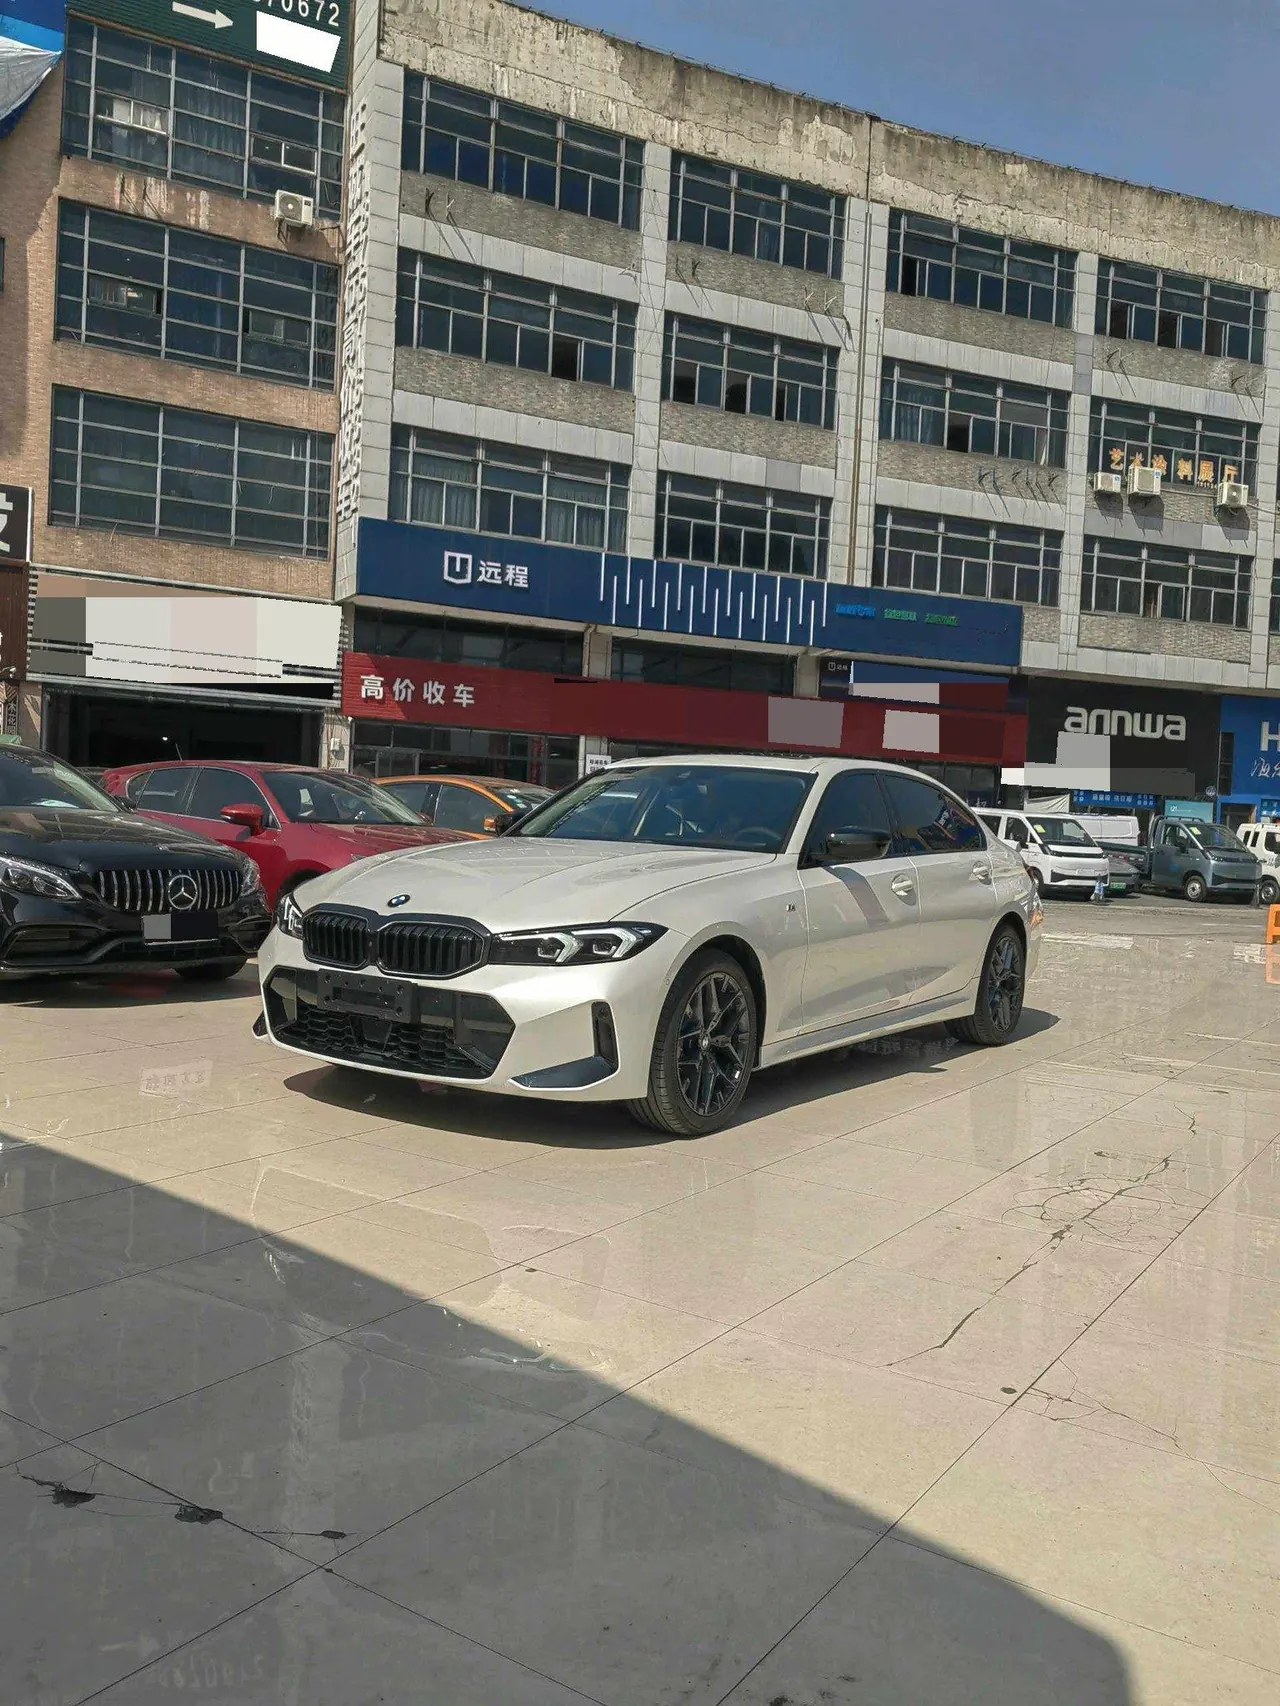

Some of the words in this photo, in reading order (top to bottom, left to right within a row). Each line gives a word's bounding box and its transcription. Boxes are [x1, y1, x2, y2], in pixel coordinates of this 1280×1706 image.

[253, 0, 340, 27] 0672
[476, 559, 529, 588] 远程
[360, 674, 475, 708] 高价收车
